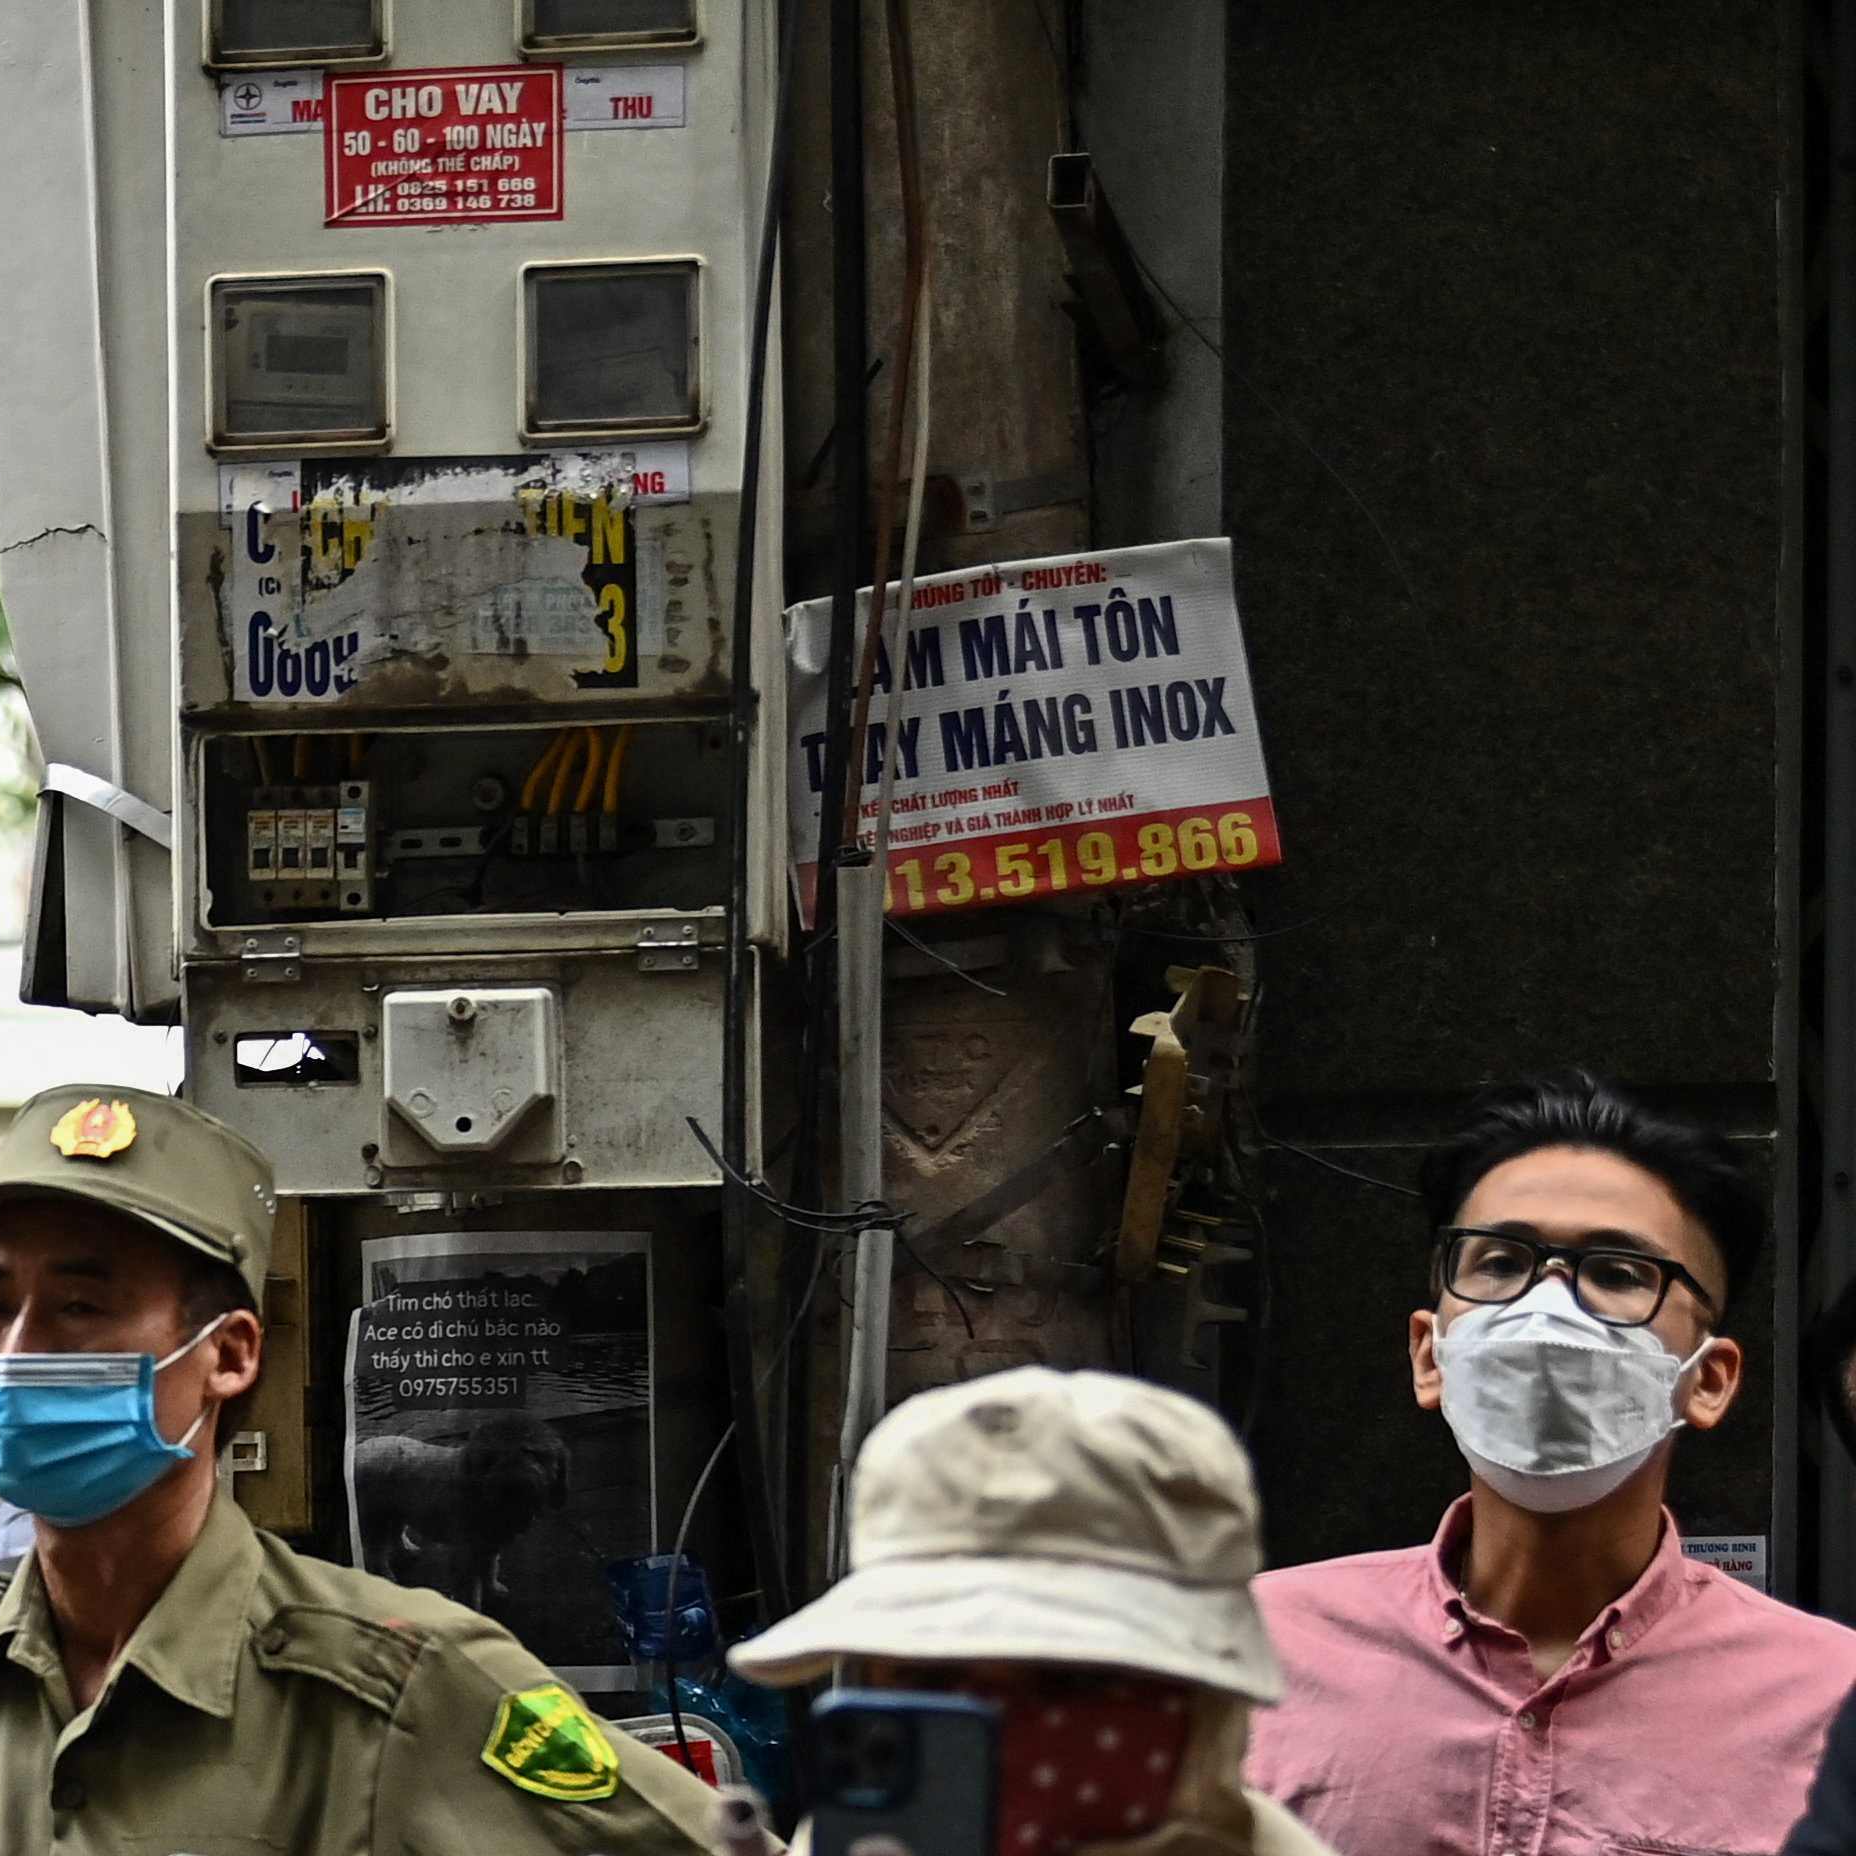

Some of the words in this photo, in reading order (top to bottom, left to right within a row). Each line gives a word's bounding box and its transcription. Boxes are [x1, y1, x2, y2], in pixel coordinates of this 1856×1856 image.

[364, 86, 443, 121] CHO
[455, 83, 524, 116] VAY
[343, 130, 371, 156] 50
[393, 127, 420, 153] 60
[443, 124, 480, 150] 100
[486, 118, 546, 149] NGÀY
[371, 157, 432, 177] (KHÔNG
[470, 151, 520, 172] CHẤP)
[397, 180, 447, 196] 0825
[454, 178, 488, 192] 151
[497, 177, 536, 191] 666
[397, 196, 447, 212] 0369
[455, 194, 491, 210] 146
[497, 194, 535, 208] 738
[633, 471, 665, 496] NG
[902, 580, 964, 610] HÚNG
[1021, 560, 1107, 592] CHUYÊN:
[959, 598, 1064, 682] MÁI
[1073, 587, 1181, 666] TÔN
[801, 716, 921, 793] TAY
[939, 689, 1099, 772] MÁNG
[1109, 676, 1236, 749] INOX
[892, 791, 929, 813] CHẤT
[982, 777, 1020, 800] NHẤT
[945, 812, 964, 836] VÀ
[967, 809, 992, 833] GIÁ
[994, 804, 1044, 828] THÀNH
[1045, 801, 1074, 824] HỢP
[1078, 796, 1097, 817] LÝ
[1099, 792, 1136, 813] NHẤT
[422, 1290, 452, 1311] chó
[364, 1325, 397, 1341] Ace
[401, 1321, 424, 1340] cô
[446, 1319, 478, 1338] chú
[485, 1319, 519, 1337] bác
[524, 1318, 561, 1336] nào
[371, 1348, 410, 1373] thấy
[441, 1349, 474, 1367] cho
[479, 1353, 492, 1366] e
[497, 1350, 525, 1366] xin
[529, 1349, 550, 1366] tt
[399, 1376, 519, 1398] 0975755351
